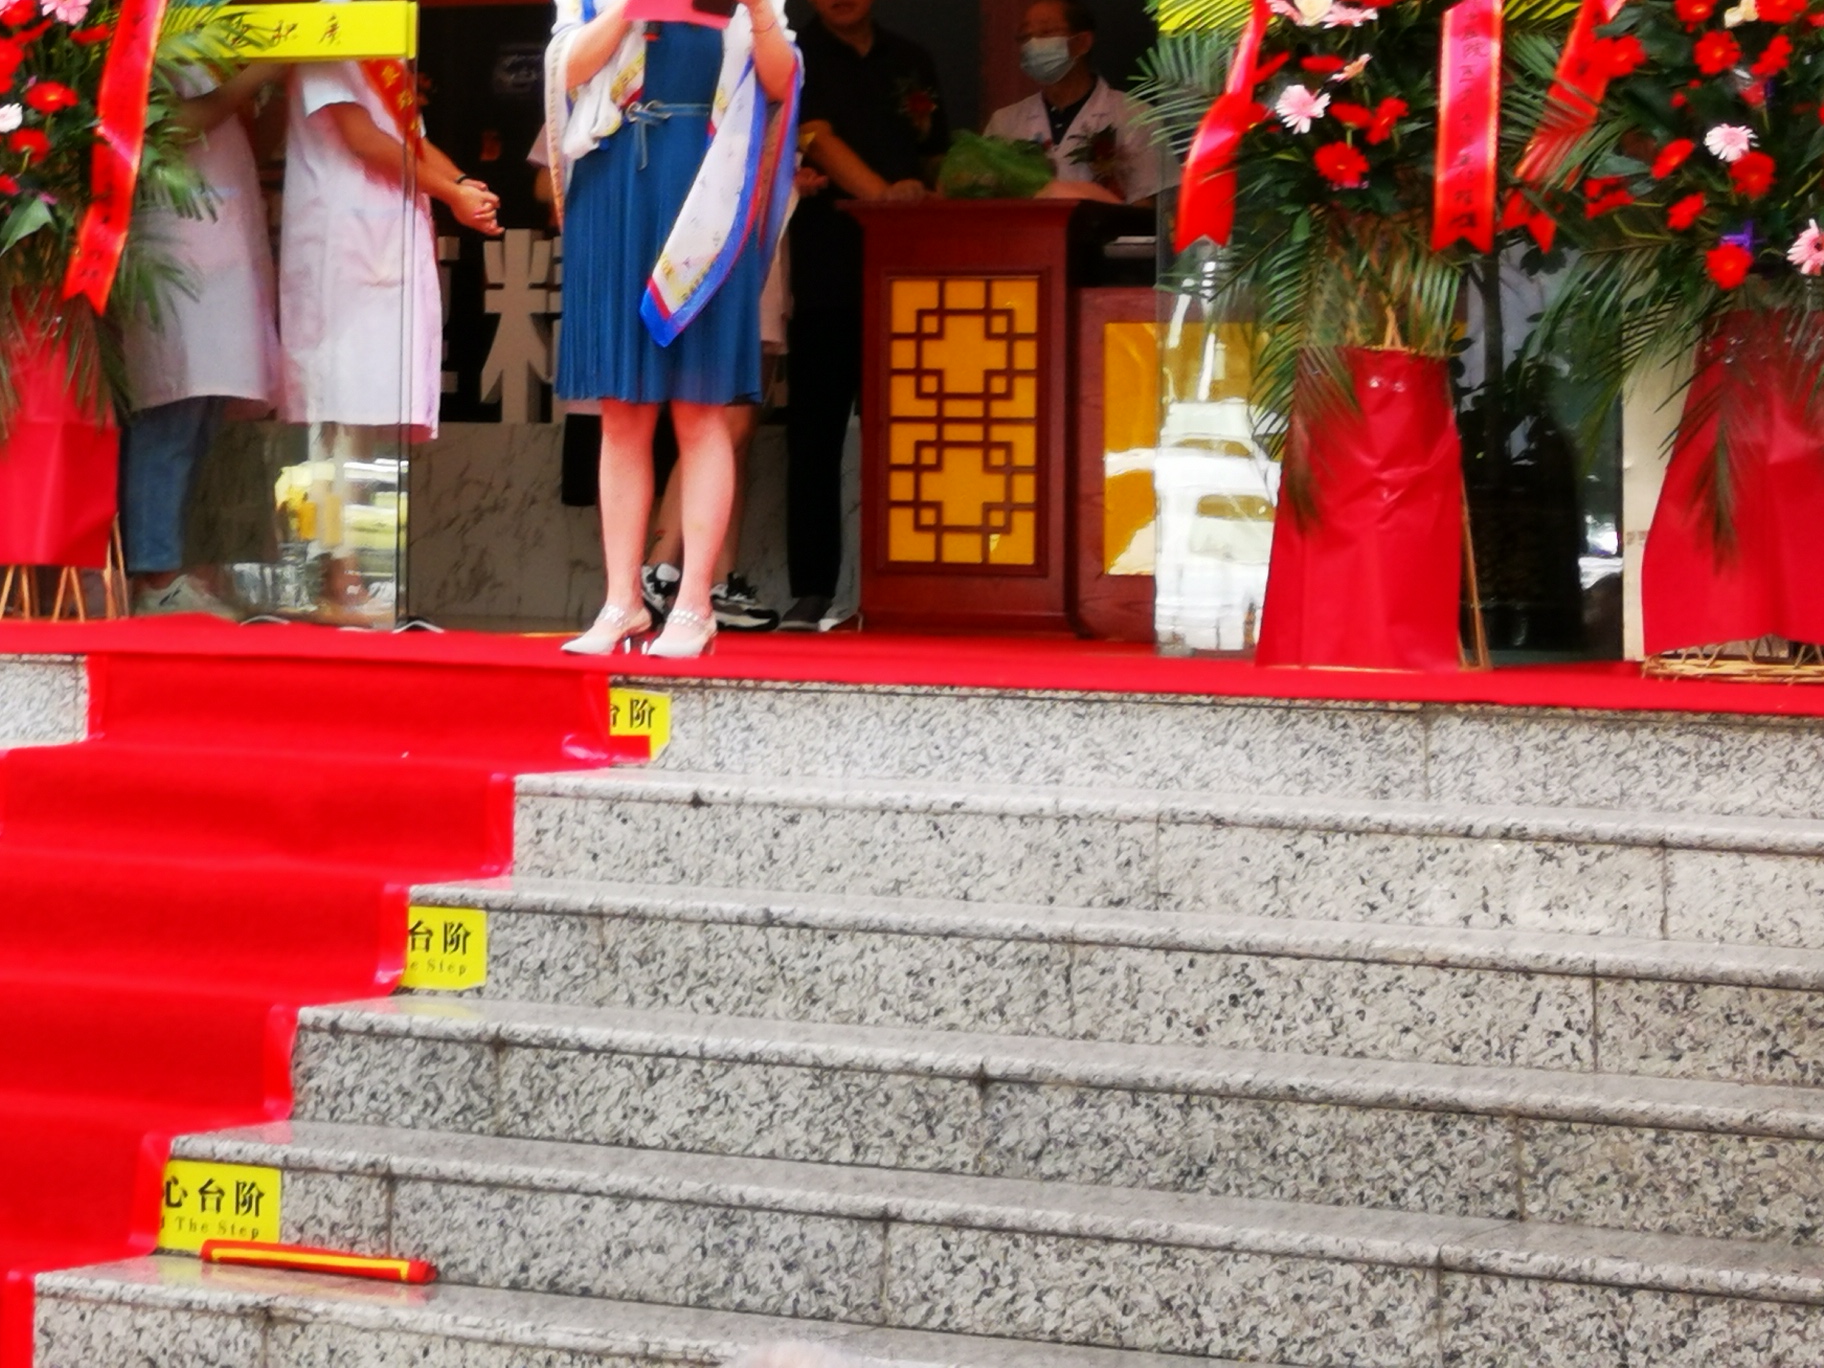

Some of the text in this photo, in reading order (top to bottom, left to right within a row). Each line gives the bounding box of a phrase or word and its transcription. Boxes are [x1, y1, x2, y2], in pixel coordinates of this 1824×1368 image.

[409, 919, 472, 956] 台阶
[163, 1175, 266, 1218] 心台阶
[175, 1215, 209, 1234] The
